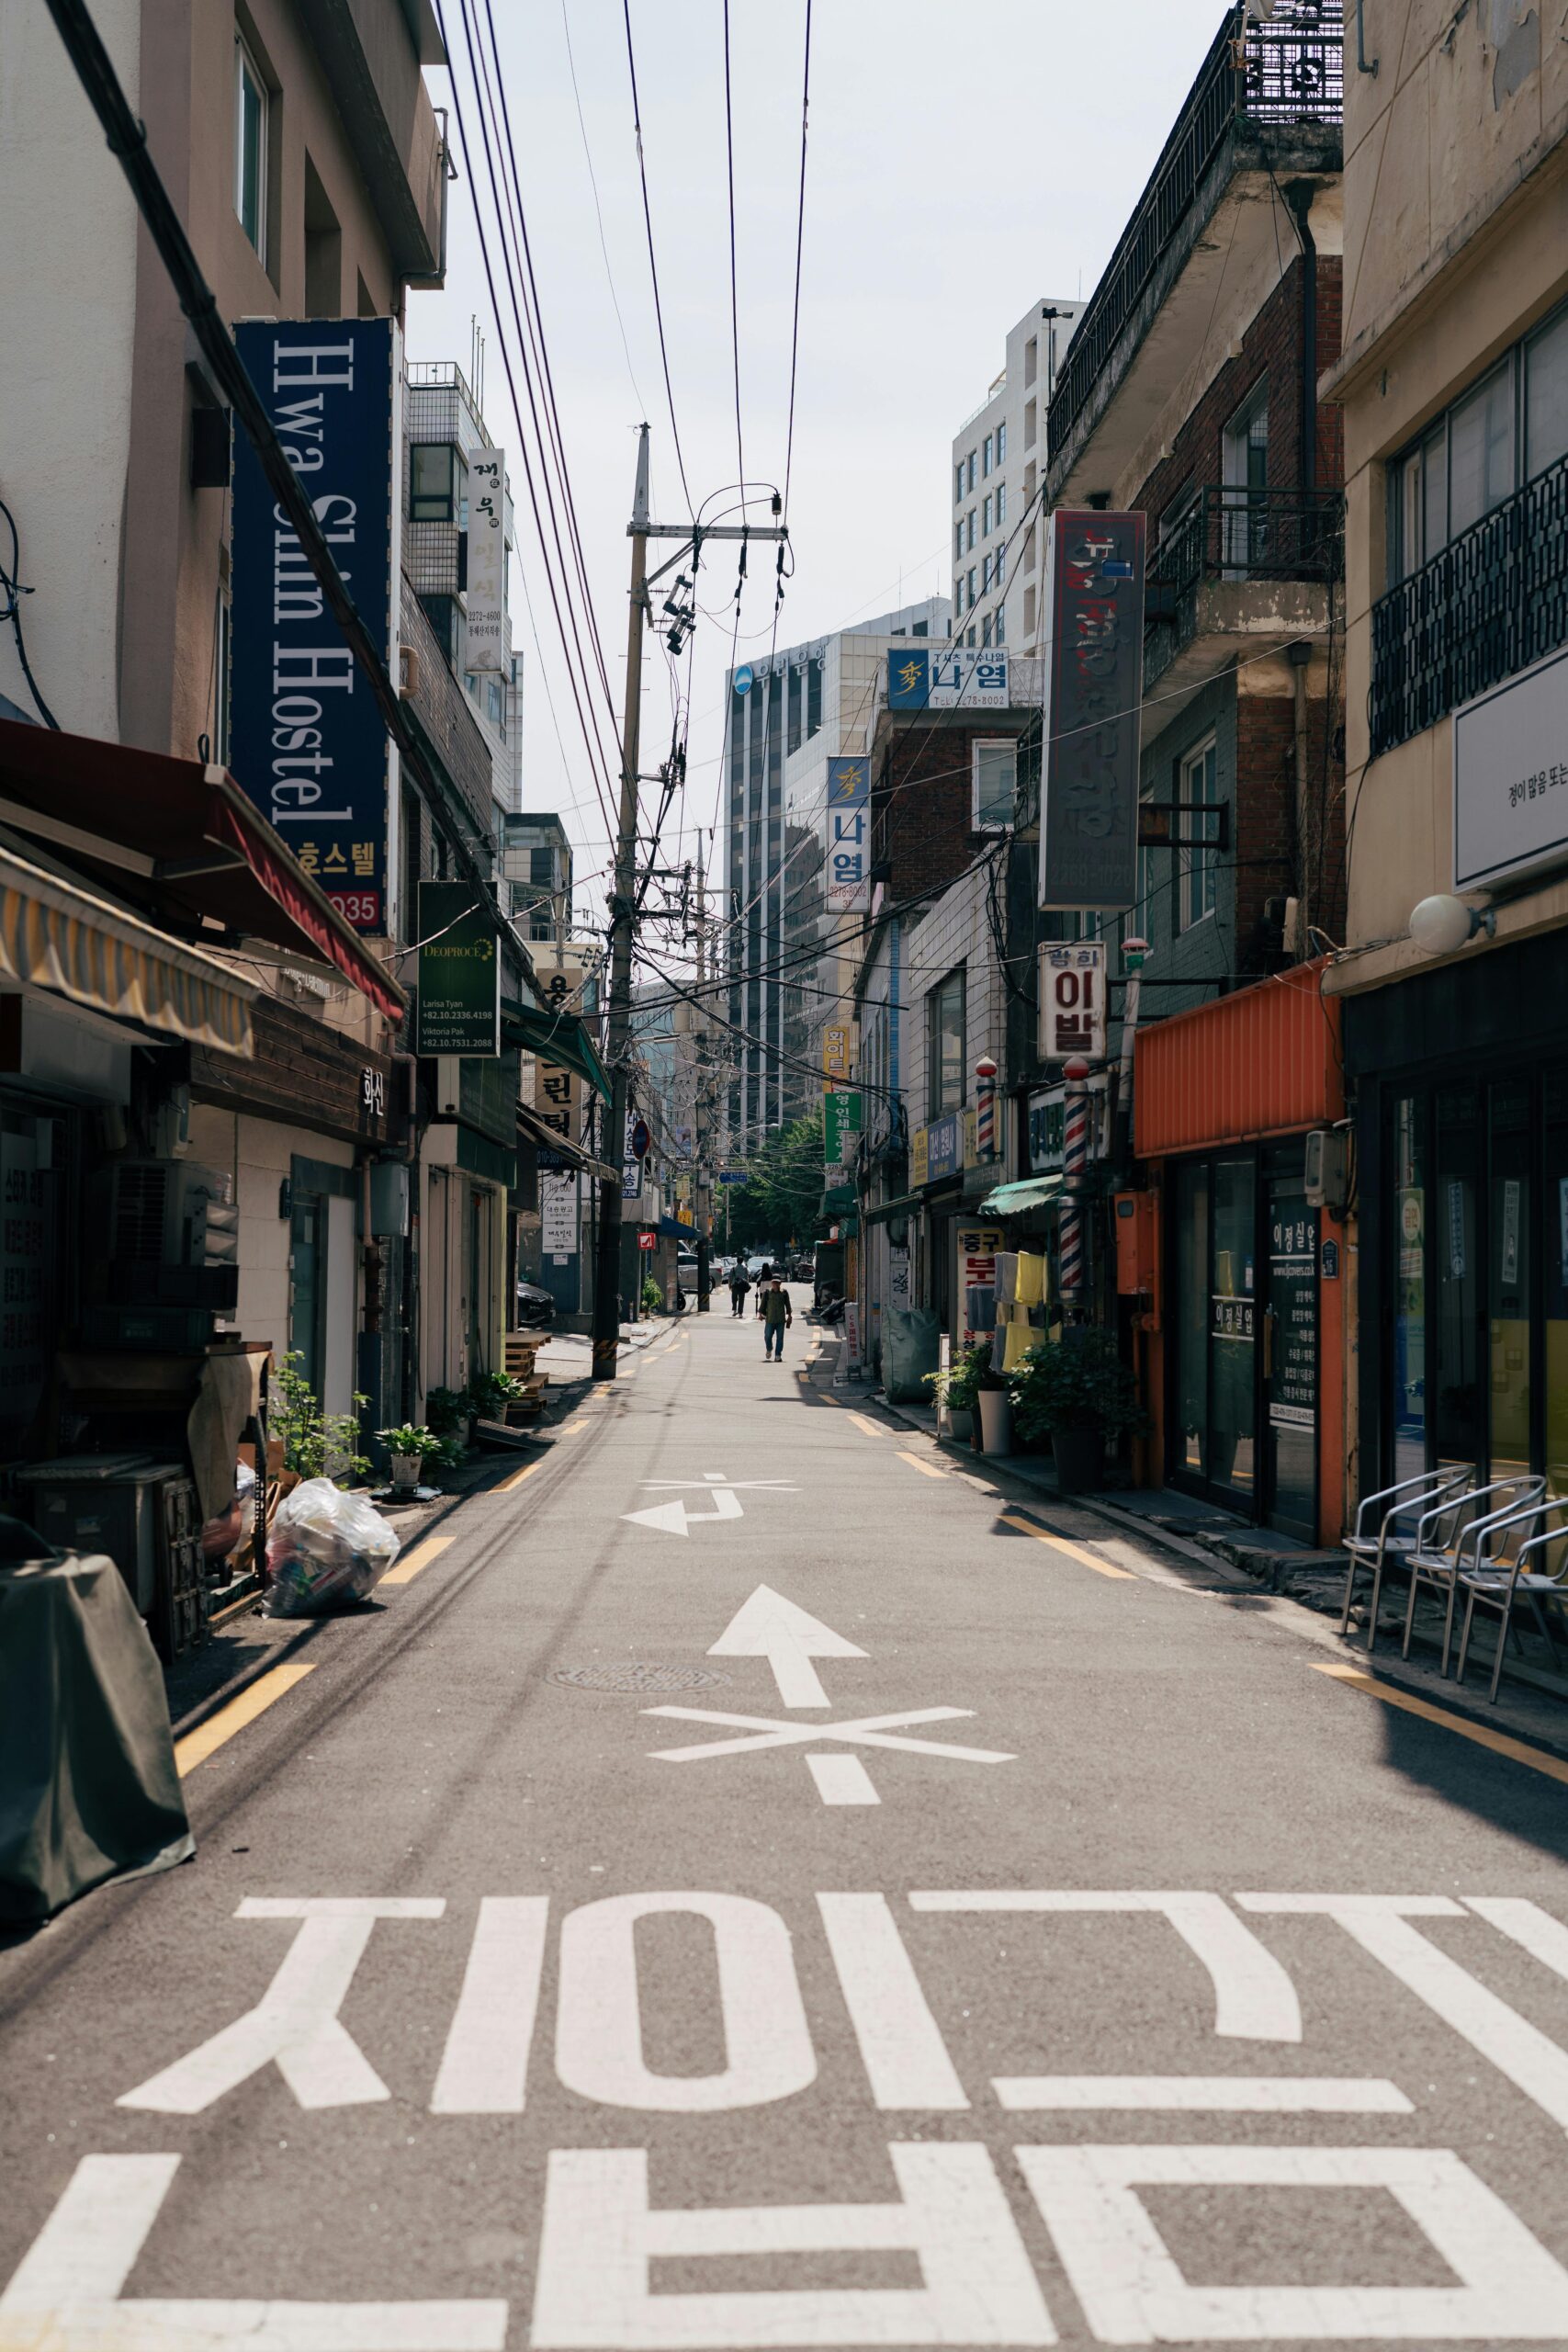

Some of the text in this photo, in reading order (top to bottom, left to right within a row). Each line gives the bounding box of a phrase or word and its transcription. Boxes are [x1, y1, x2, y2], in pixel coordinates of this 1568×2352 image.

[274, 338, 354, 472] Hwa
[468, 611, 501, 621] 2272-4600
[756, 645, 826, 689] 우리은행
[932, 664, 1006, 690] 나염
[271, 641, 356, 824] Hostel
[1508, 779, 1526, 808] 정이
[1529, 771, 1546, 799] 많음
[284, 841, 375, 876] 호스텔
[833, 815, 866, 882] 나염
[422, 1012, 492, 1020] +82.10.2336.4198
[423, 1000, 463, 1010] Larisa Tyan
[1055, 971, 1098, 1051] 이발
[422, 1027, 465, 1035] Viktoria Pak
[422, 1039, 492, 1047] +82.10.7531.2088
[828, 1031, 845, 1071] 화이트
[364, 1068, 384, 1116] 화신
[964, 1233, 999, 1252] 중구
[1215, 1302, 1253, 1334] 이정실업
